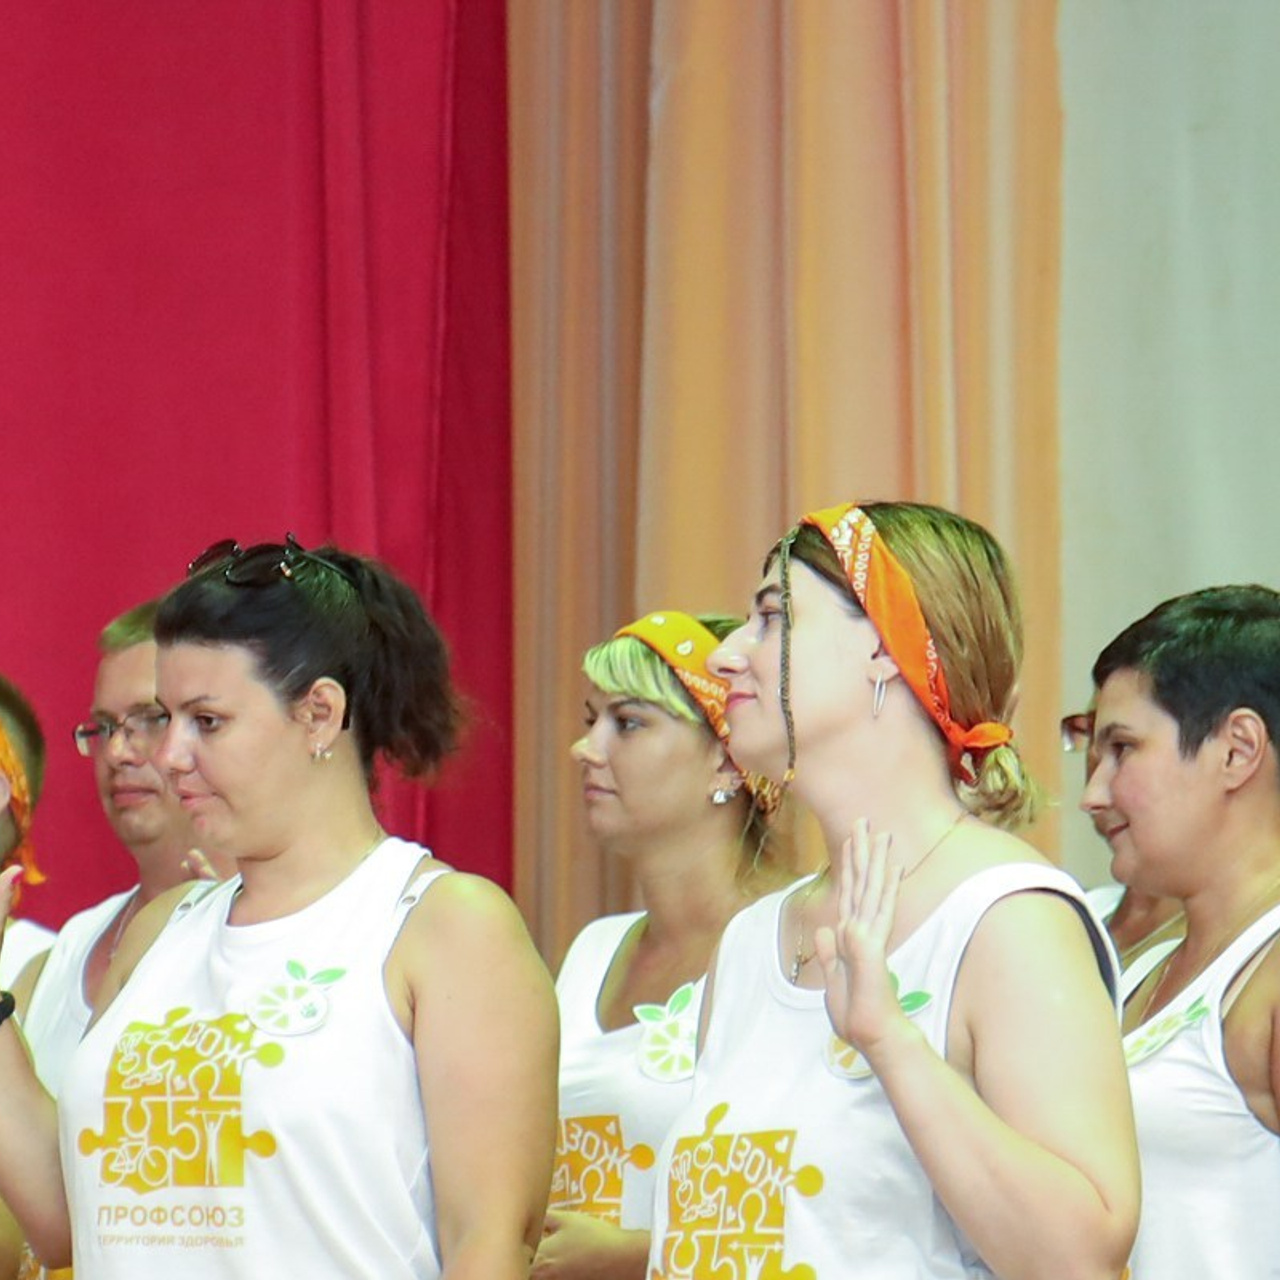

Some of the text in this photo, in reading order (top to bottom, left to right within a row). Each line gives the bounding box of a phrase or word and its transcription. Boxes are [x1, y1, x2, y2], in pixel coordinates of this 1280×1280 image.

[566, 1122, 630, 1180] ЗОЖ
[730, 1136, 795, 1204] ЗОЖ
[97, 1204, 245, 1227] ПРОФСОЮЗ
